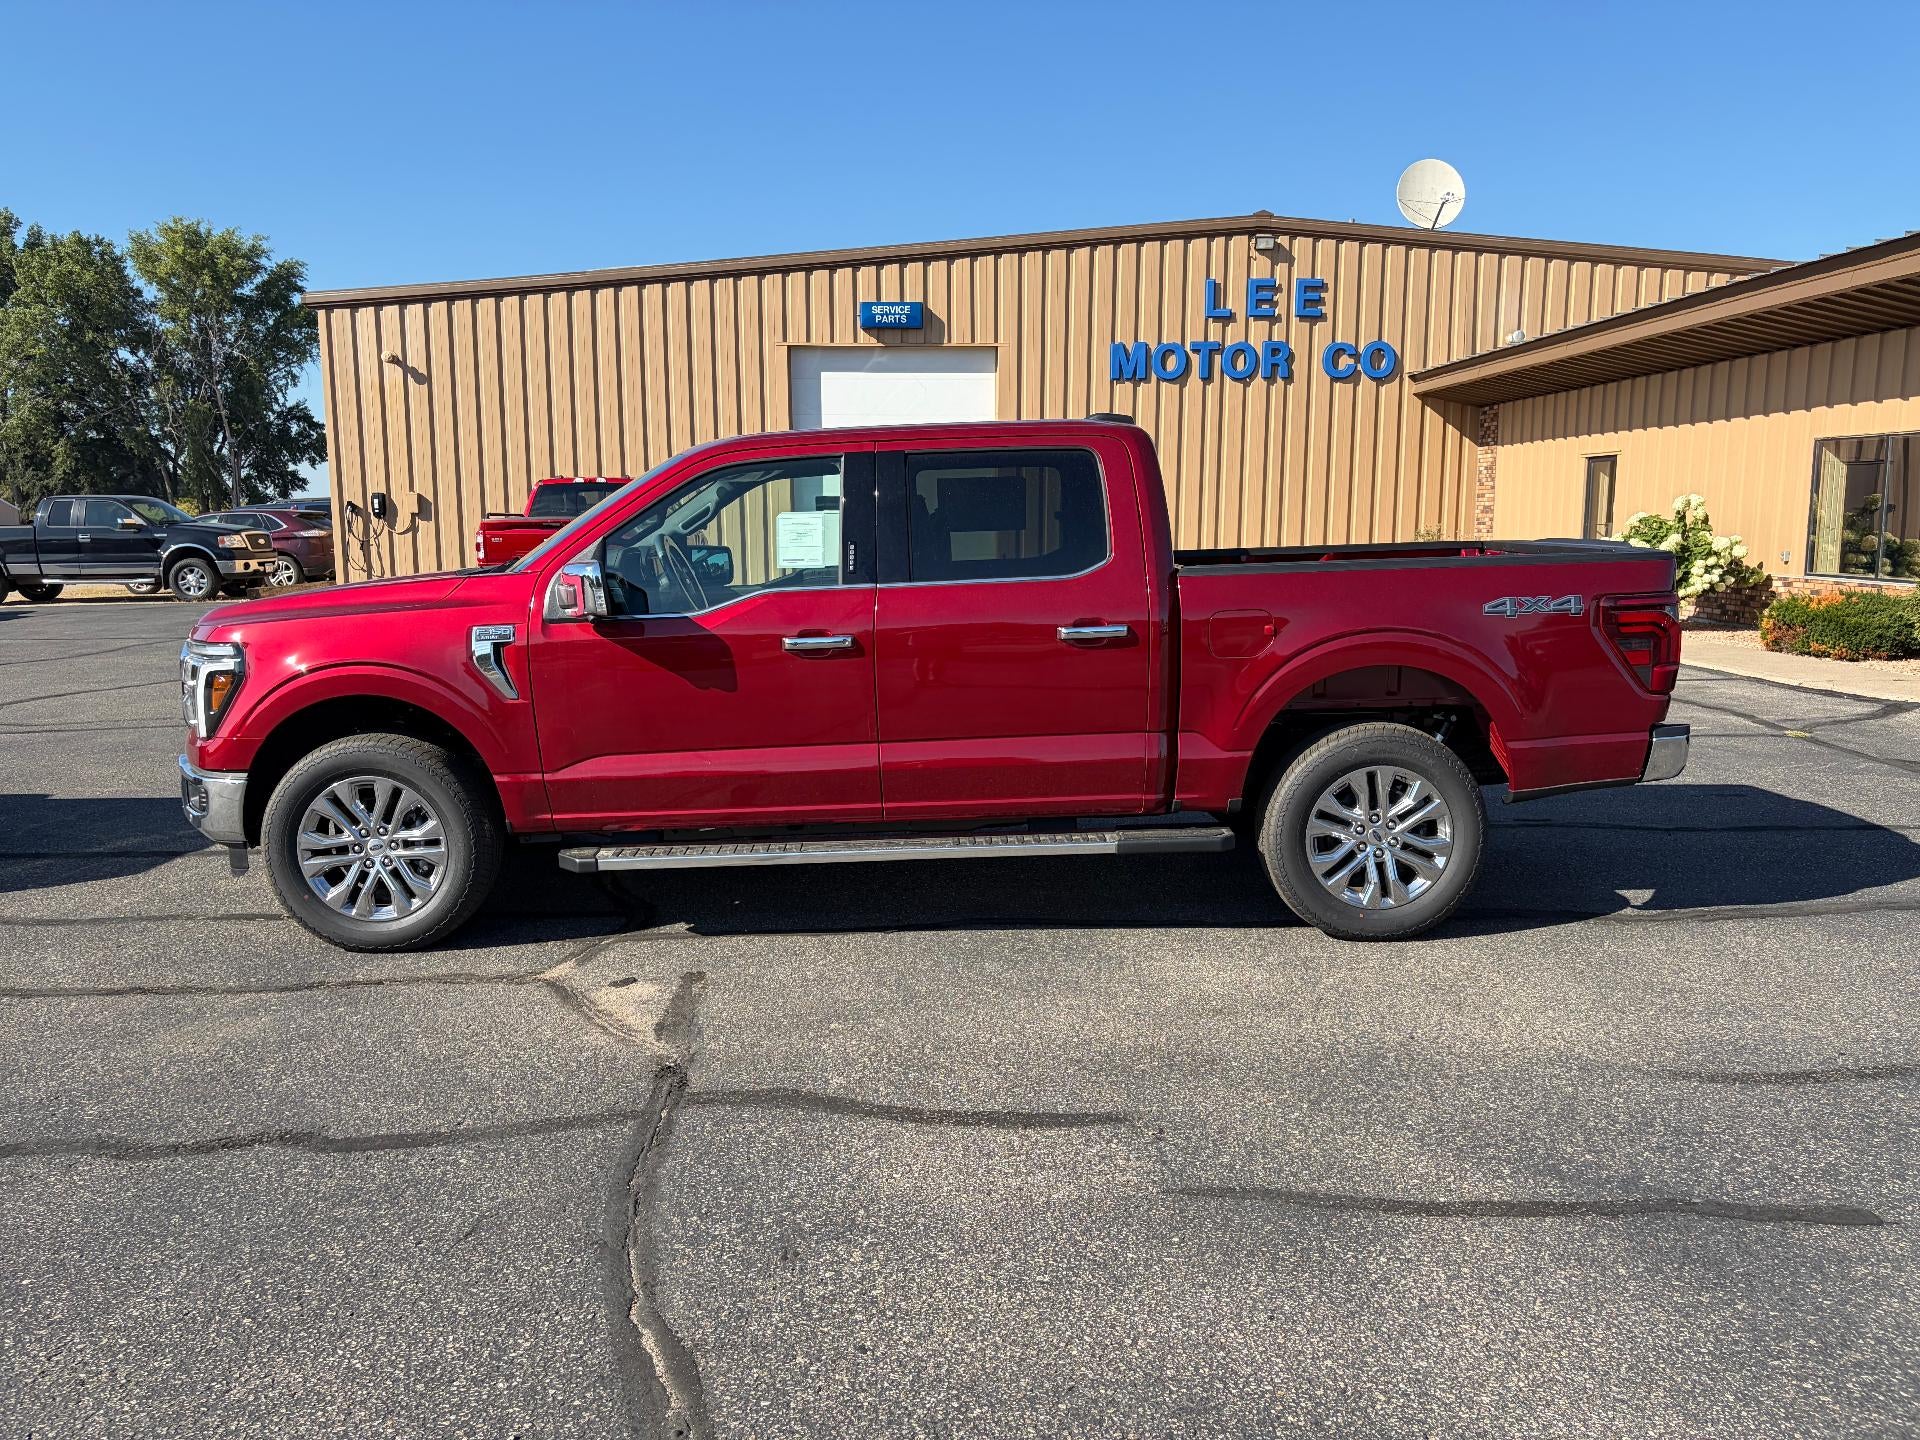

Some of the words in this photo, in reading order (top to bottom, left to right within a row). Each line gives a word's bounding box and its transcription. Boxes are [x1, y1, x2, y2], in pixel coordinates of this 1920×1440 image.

[871, 305, 911, 314] SERVICE
[1205, 278, 1325, 318] LEE
[875, 314, 907, 324] PARTS
[1110, 341, 1291, 381] MOTOR
[1322, 341, 1397, 381] CO
